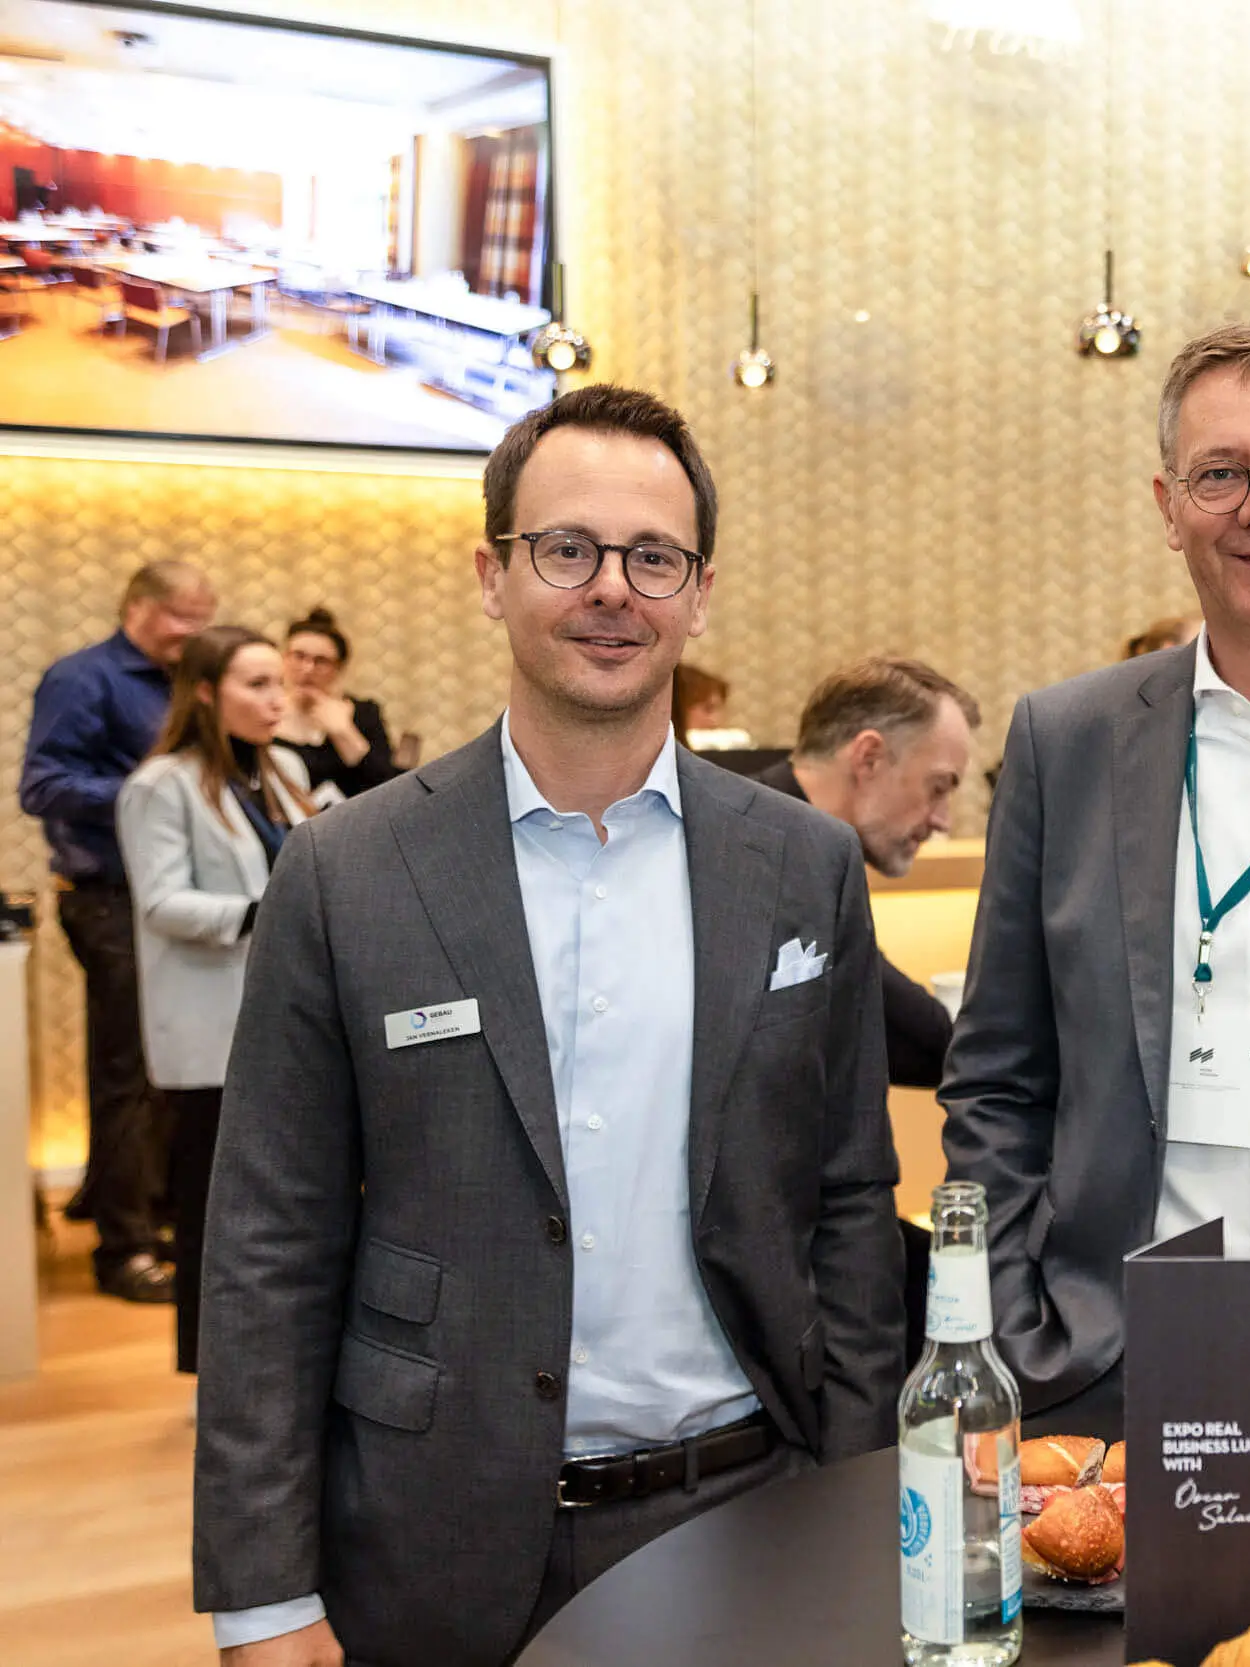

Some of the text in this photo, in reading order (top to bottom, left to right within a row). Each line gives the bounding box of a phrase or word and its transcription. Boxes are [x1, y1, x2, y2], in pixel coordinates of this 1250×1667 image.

[1162, 1421, 1242, 1437] EXPO REAL
[1162, 1438, 1230, 1455] BUSINESS
[1162, 1456, 1202, 1472] WITH
